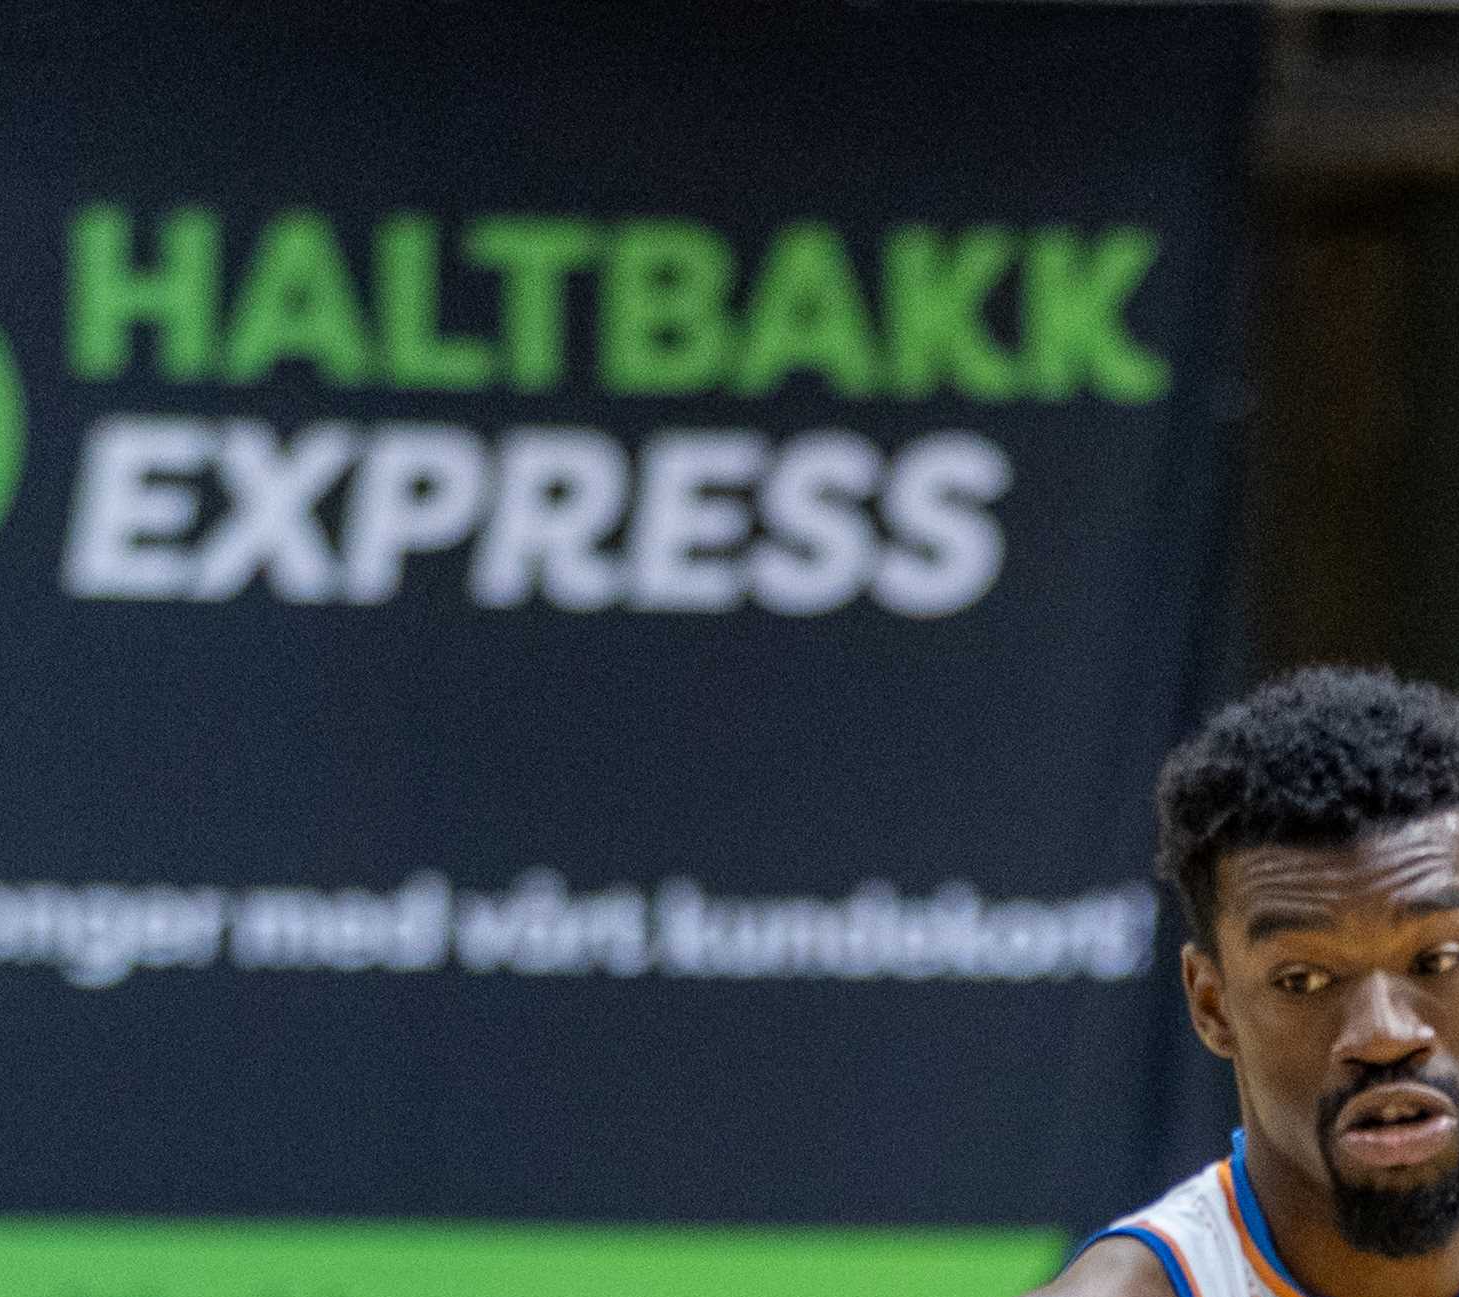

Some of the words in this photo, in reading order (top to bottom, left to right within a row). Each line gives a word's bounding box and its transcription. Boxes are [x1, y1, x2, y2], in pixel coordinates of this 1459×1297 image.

[63, 201, 1172, 405] HALTBAKK
[63, 415, 1016, 619] EXPRESS
[230, 868, 448, 974] med
